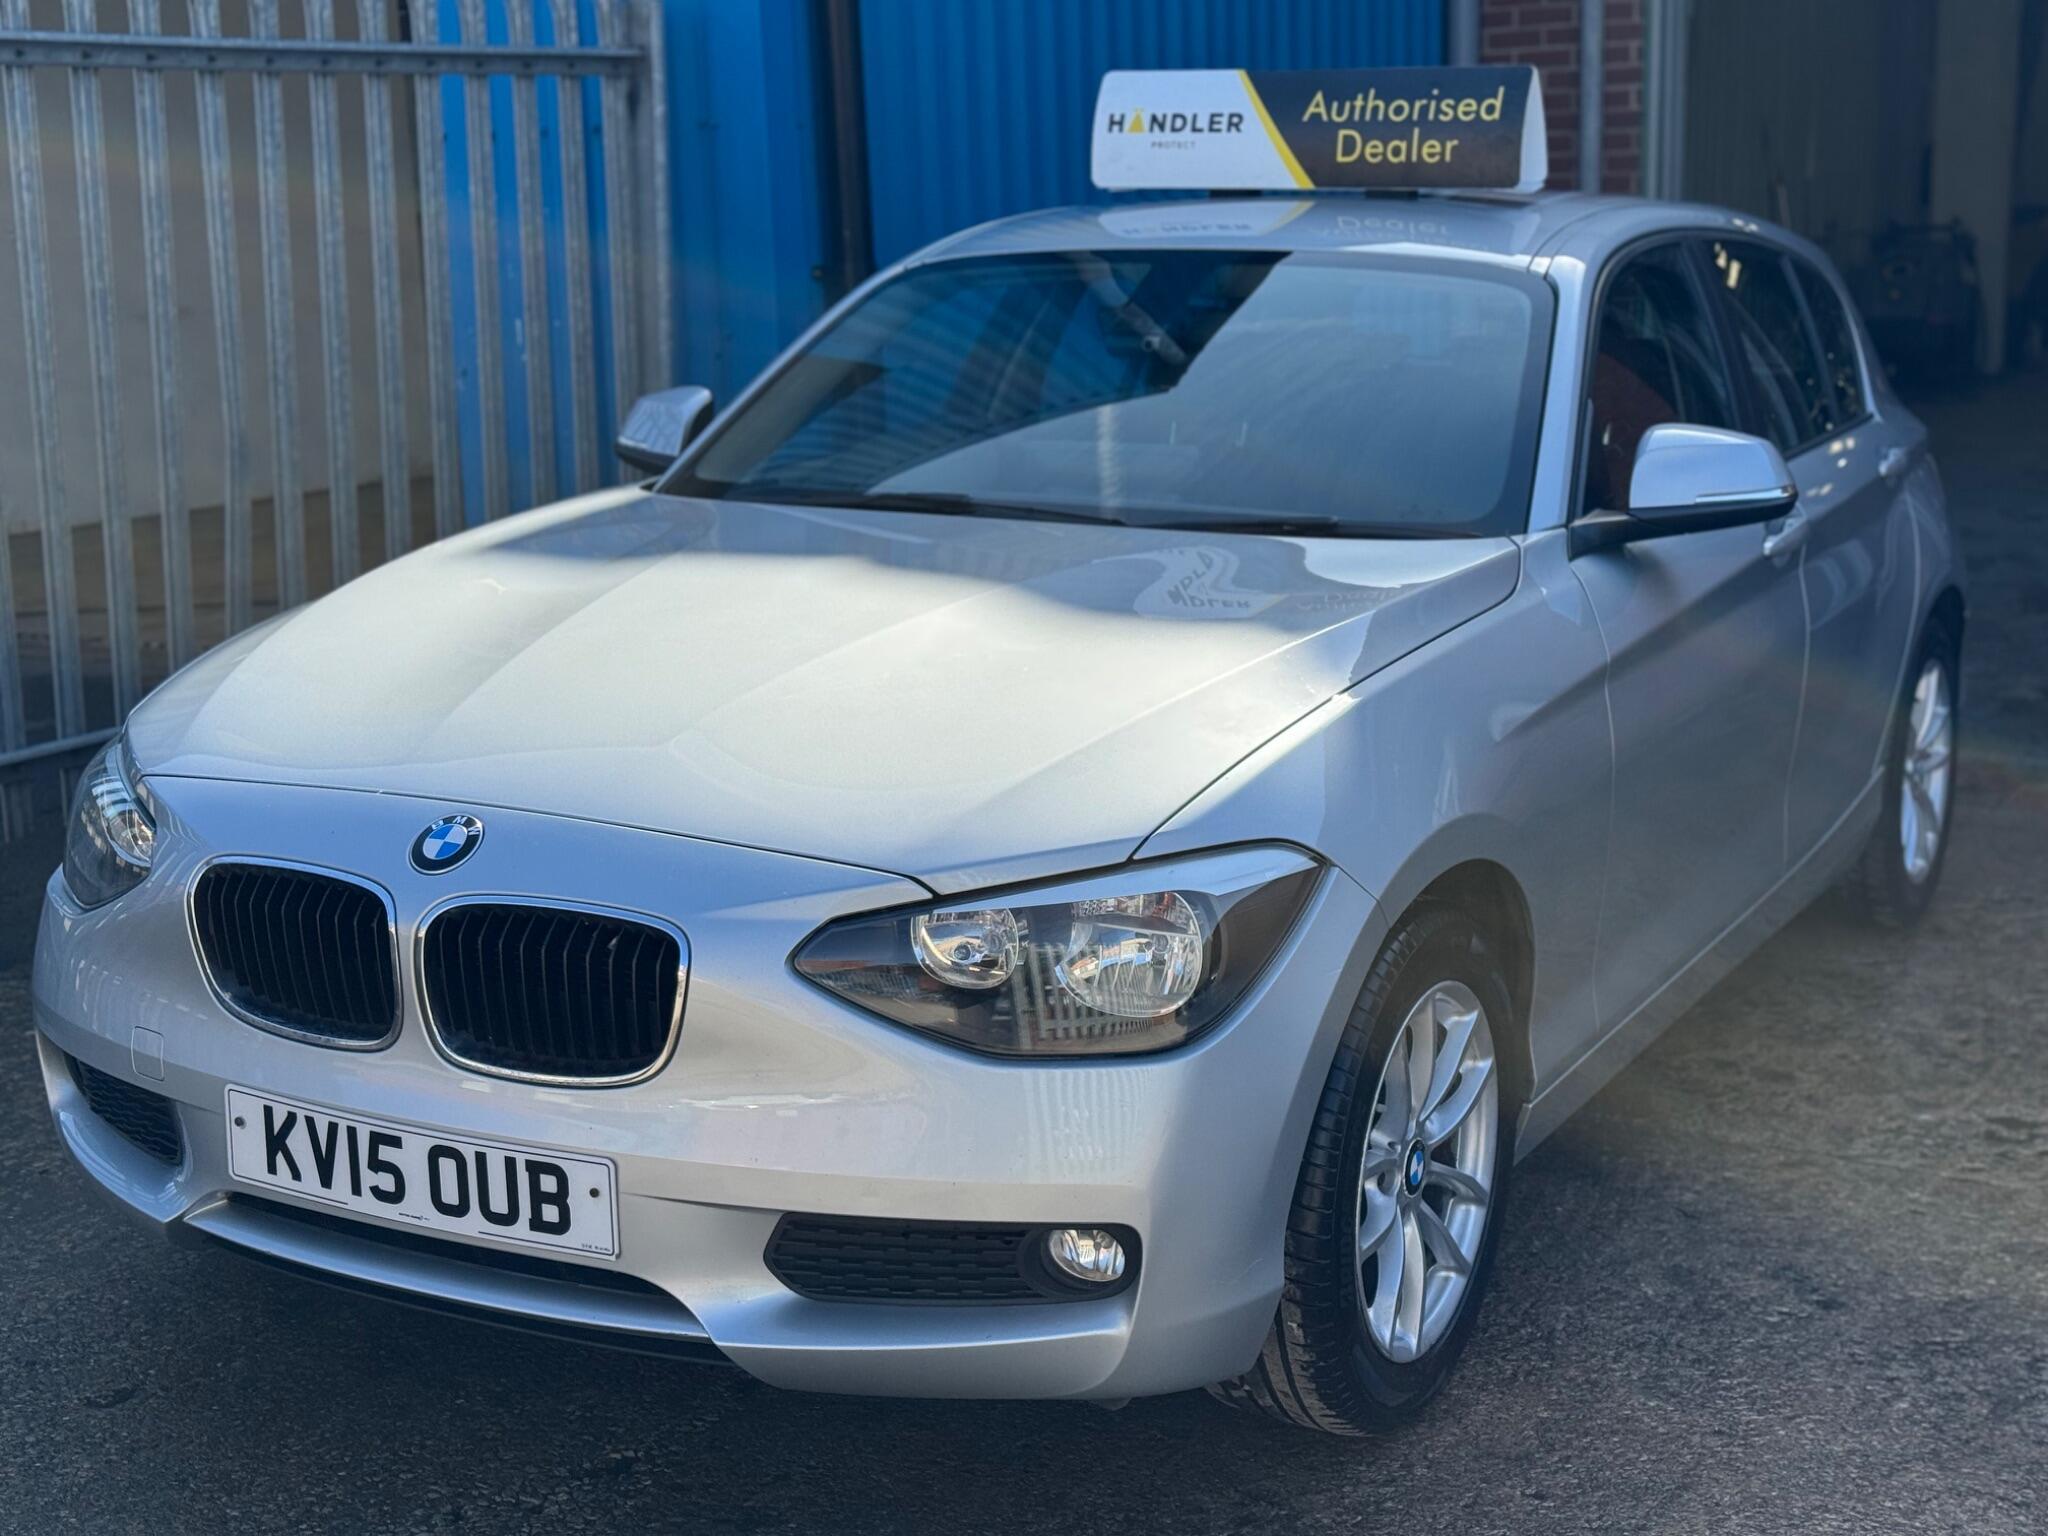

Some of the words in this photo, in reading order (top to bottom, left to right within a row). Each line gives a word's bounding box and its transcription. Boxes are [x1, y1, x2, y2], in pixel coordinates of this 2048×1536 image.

[1302, 86, 1505, 122] Authorised
[1336, 127, 1459, 163] Dealer
[263, 1104, 406, 1205] KV15
[427, 1144, 572, 1236] OUB
